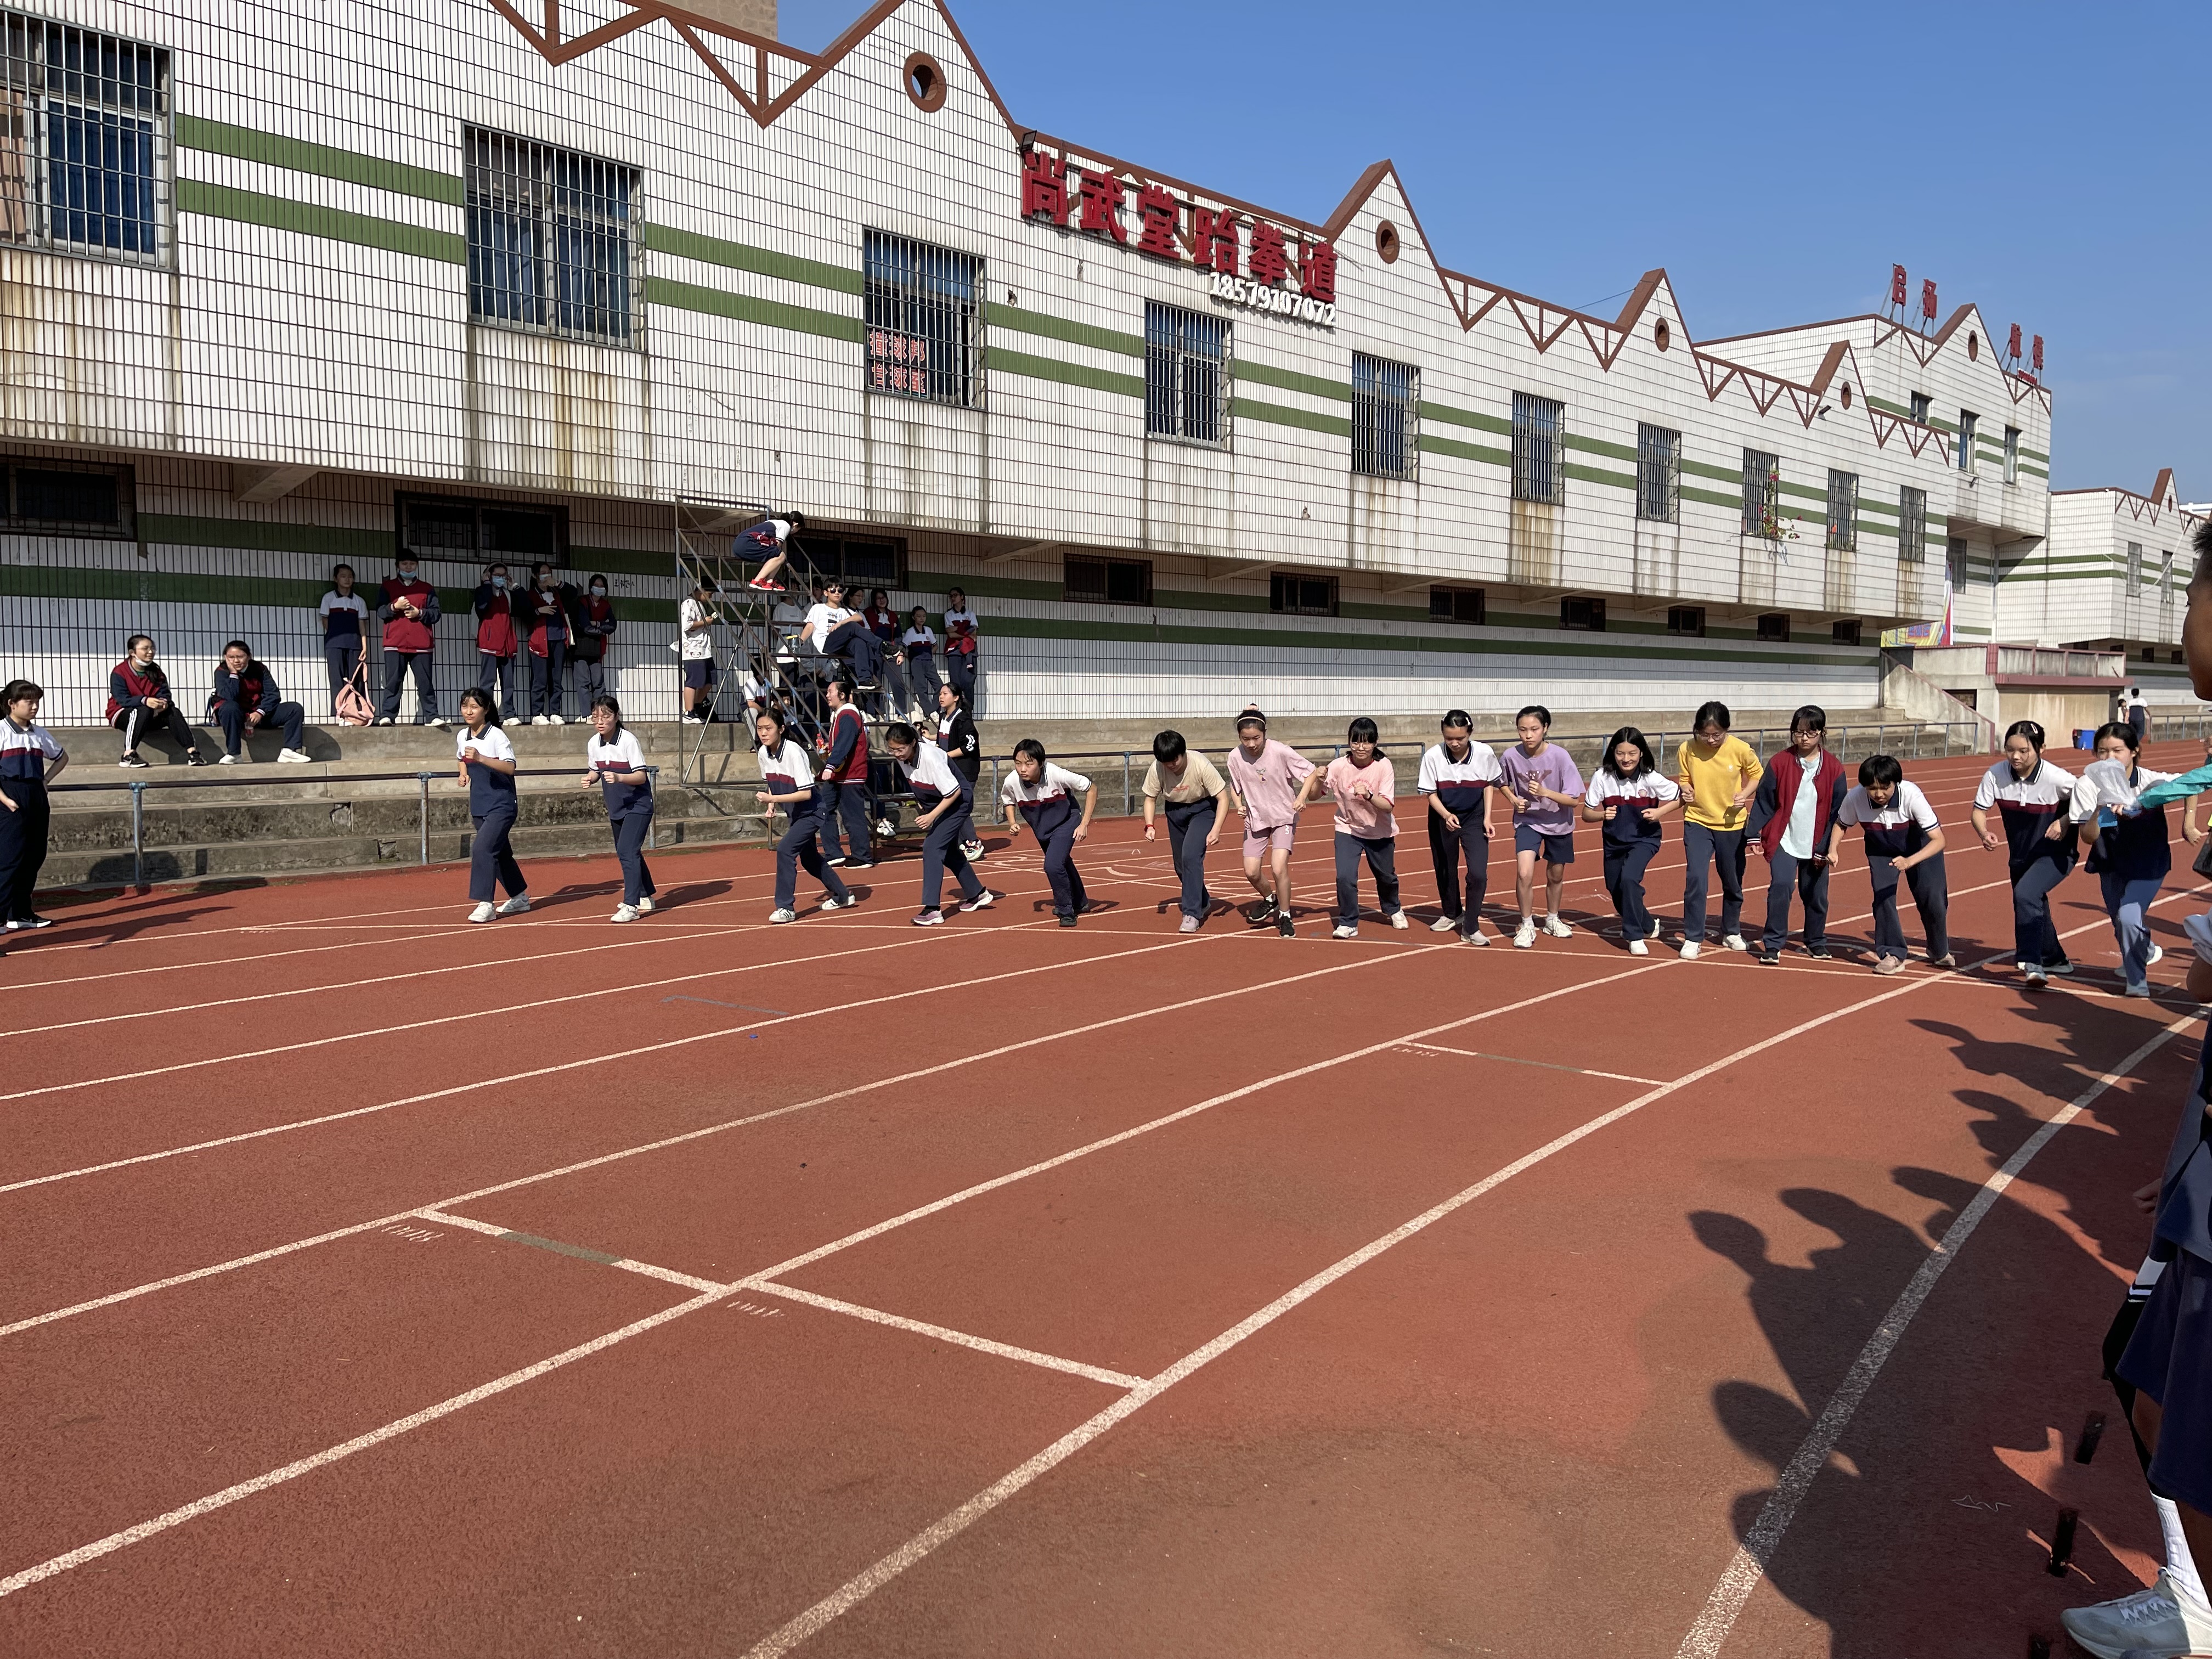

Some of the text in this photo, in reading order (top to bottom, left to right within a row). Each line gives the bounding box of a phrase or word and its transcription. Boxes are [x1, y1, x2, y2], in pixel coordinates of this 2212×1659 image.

[1022, 150, 1338, 303] 尚武堂跆拳道
[1209, 272, 1336, 326] 18579107072
